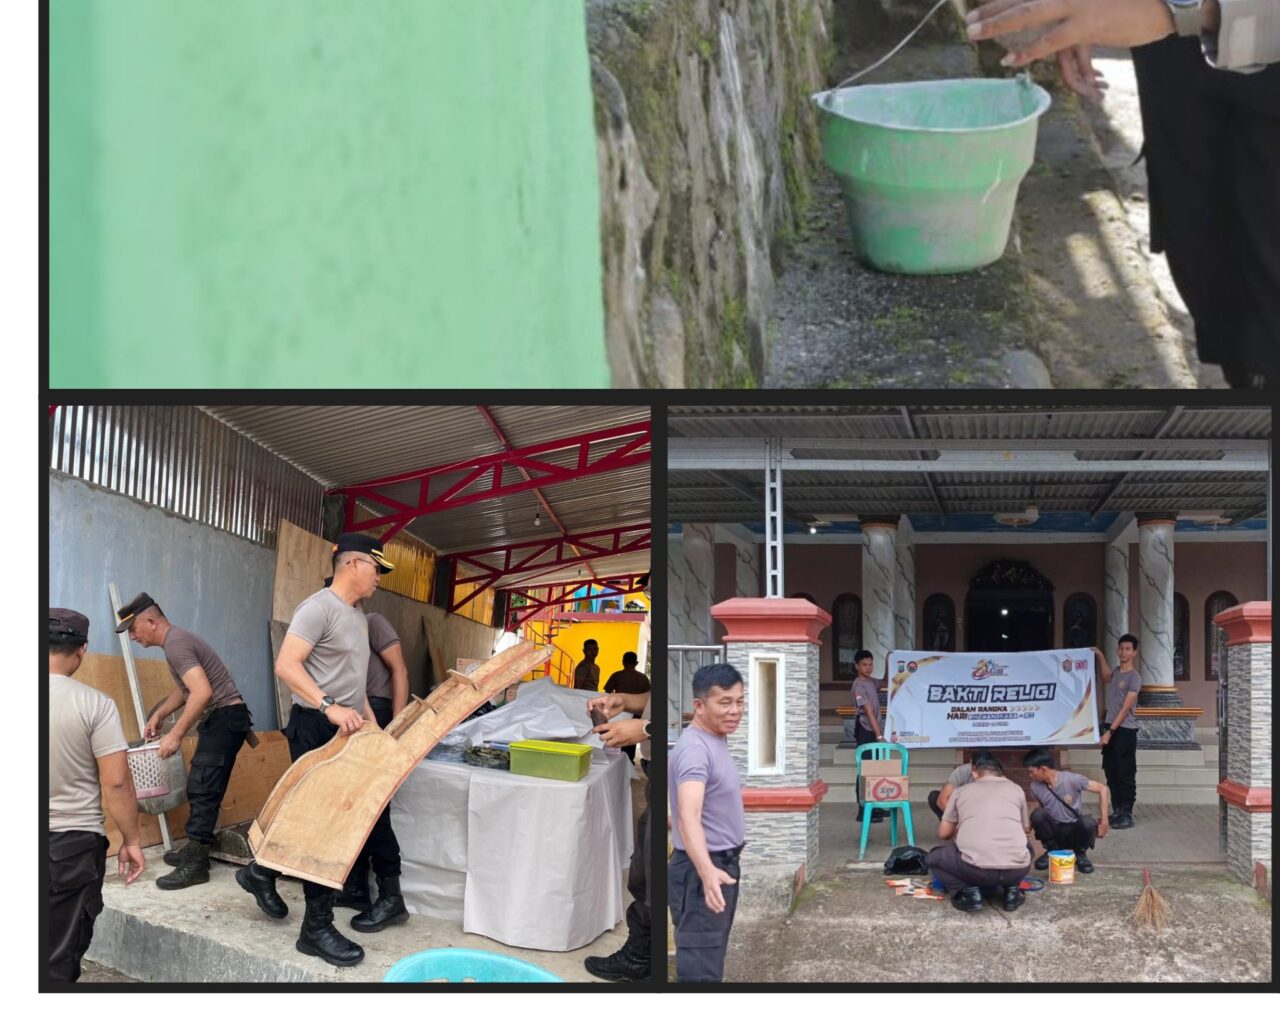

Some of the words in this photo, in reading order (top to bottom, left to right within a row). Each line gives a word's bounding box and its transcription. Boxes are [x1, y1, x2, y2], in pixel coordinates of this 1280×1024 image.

[927, 685, 989, 703] BAKTI
[991, 683, 1056, 702] RELIGI
[947, 712, 968, 721] HARI
